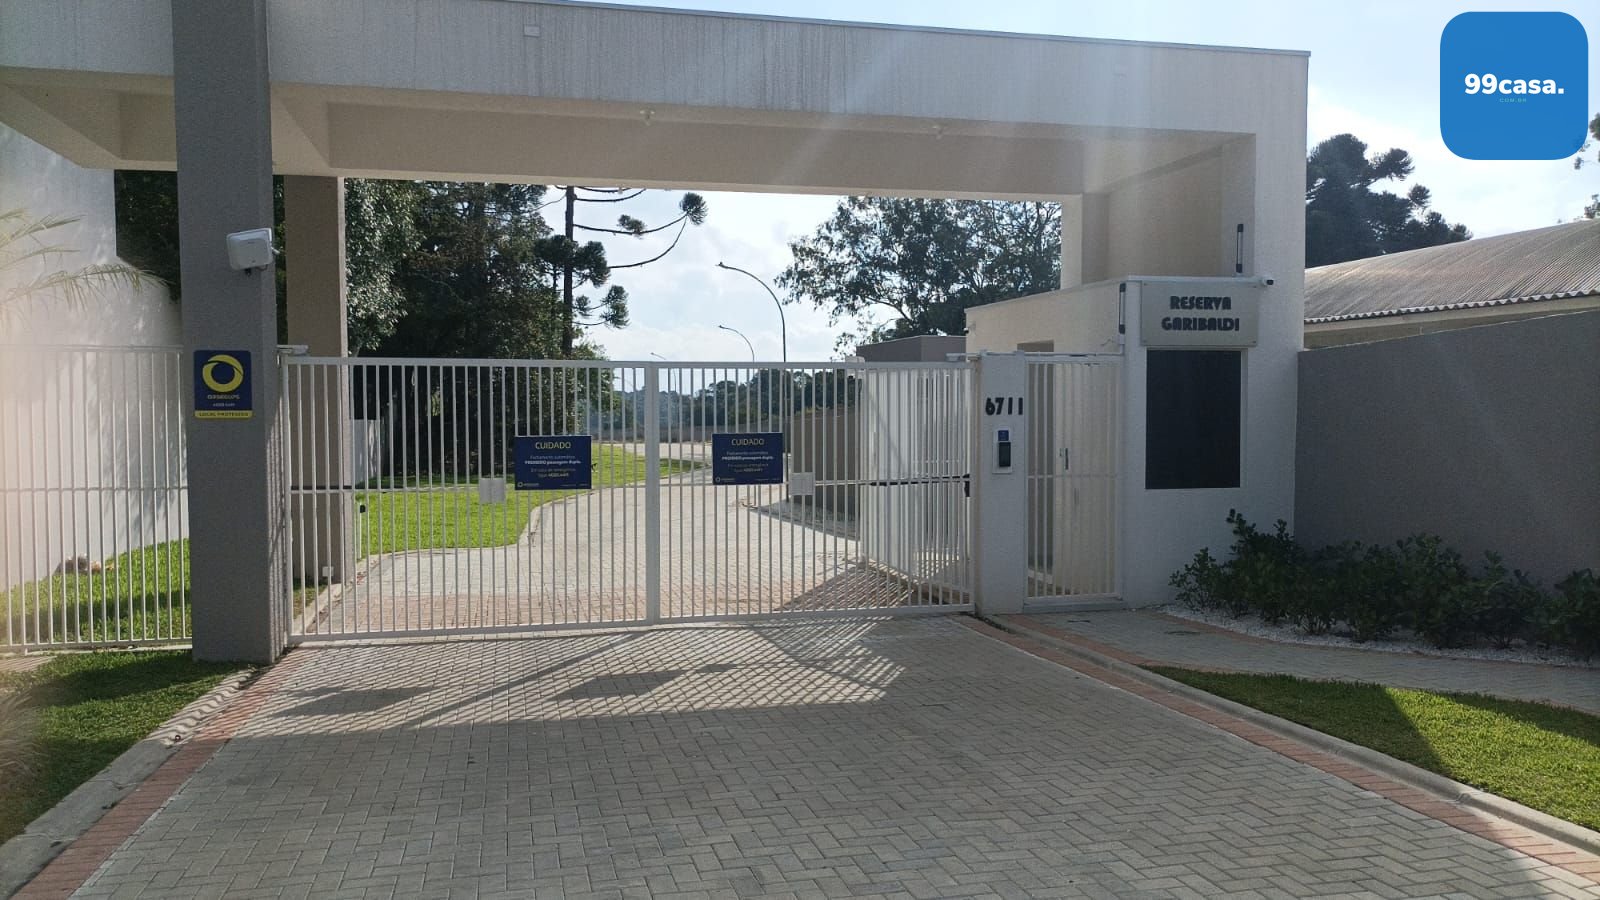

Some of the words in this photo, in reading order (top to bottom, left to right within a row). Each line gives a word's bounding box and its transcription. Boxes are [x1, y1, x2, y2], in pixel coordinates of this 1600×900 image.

[1170, 295, 1232, 310] RESERVA
[1161, 316, 1240, 331] GARIBALDI
[985, 397, 1024, 416] 6711
[535, 441, 571, 449] CUIDADO
[731, 438, 765, 446] CUIDADO
